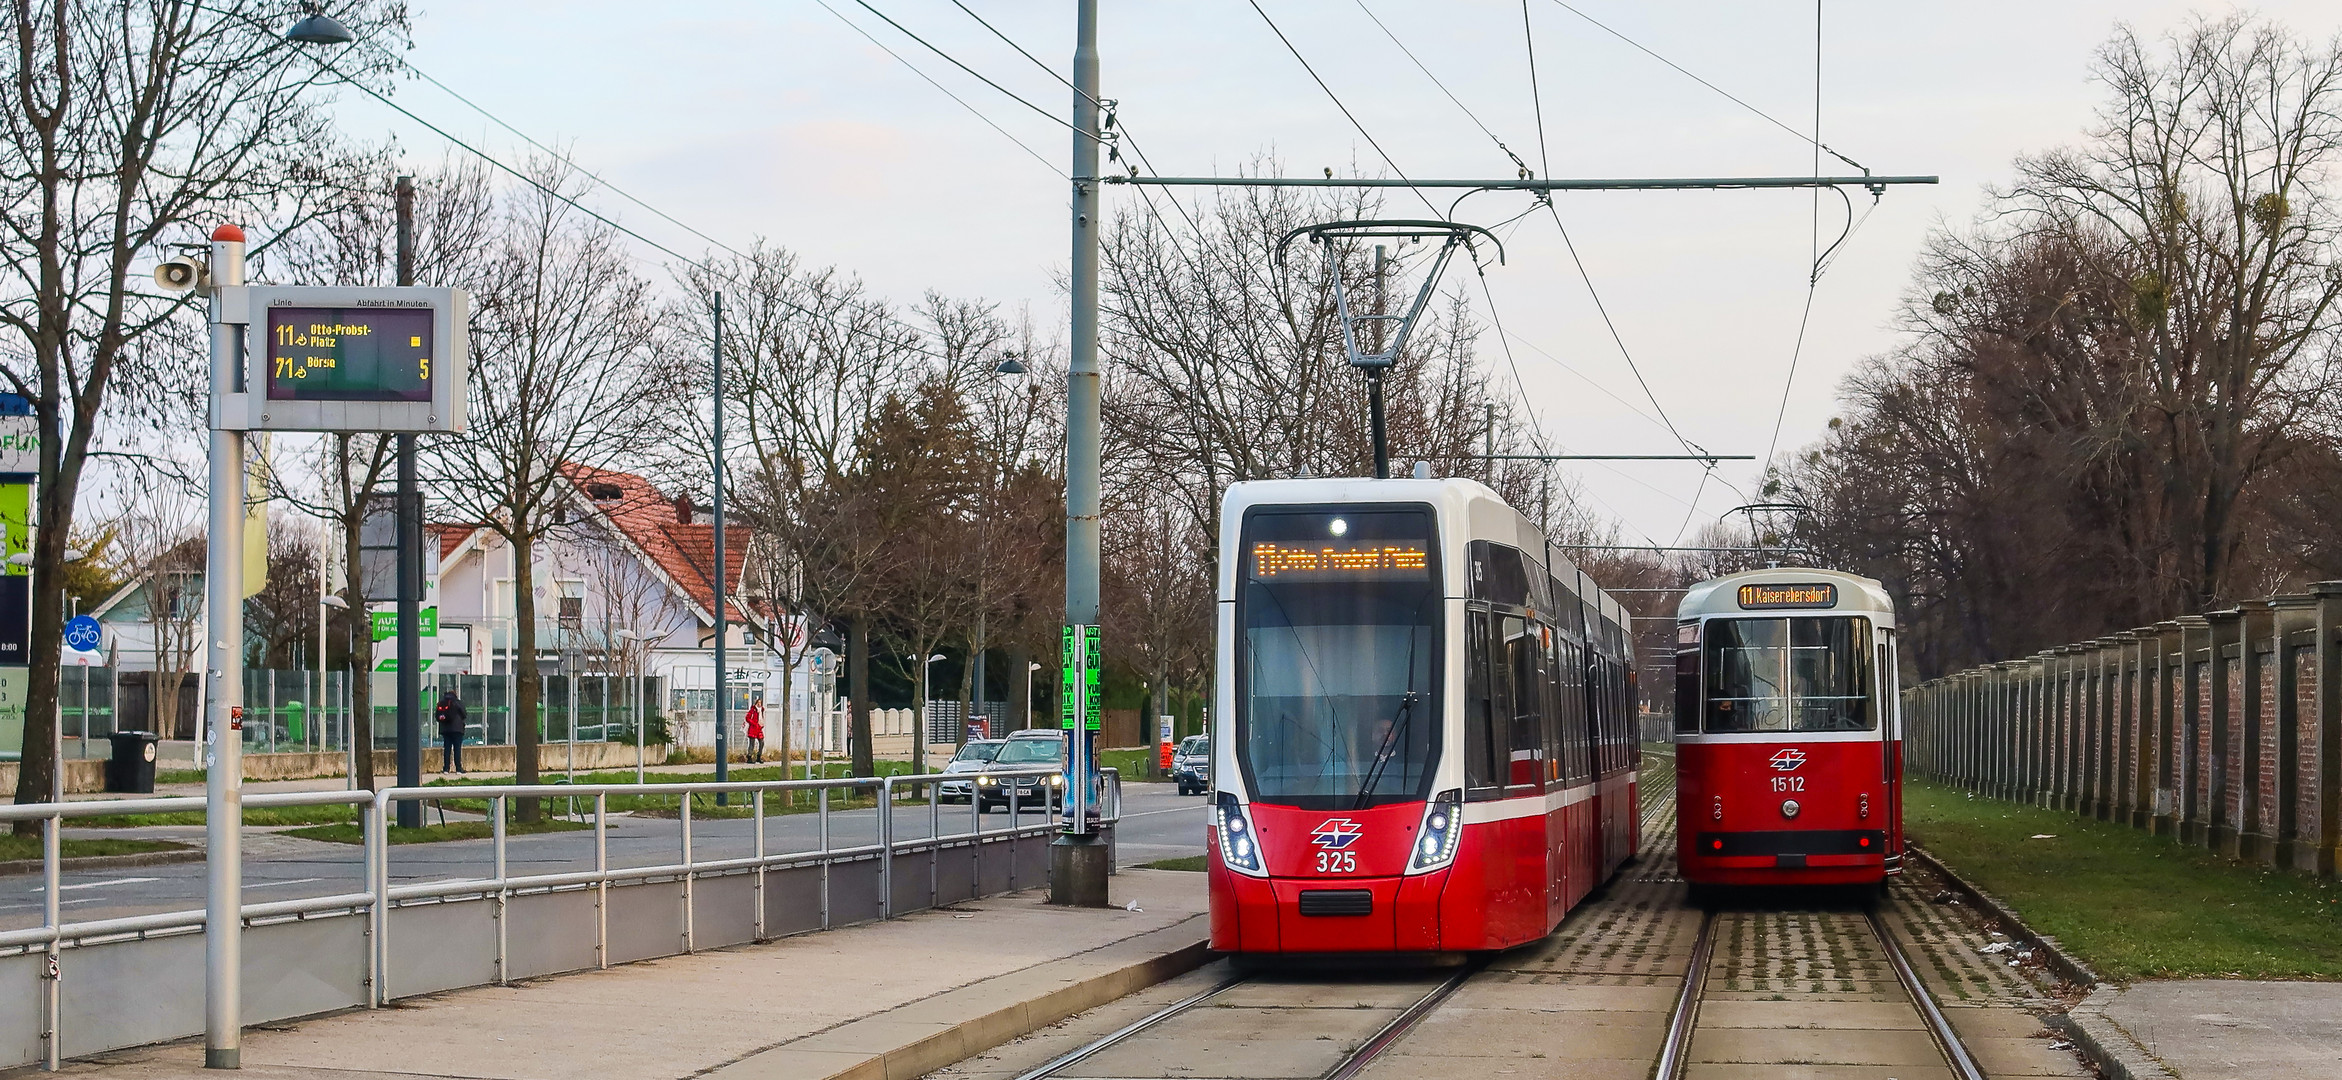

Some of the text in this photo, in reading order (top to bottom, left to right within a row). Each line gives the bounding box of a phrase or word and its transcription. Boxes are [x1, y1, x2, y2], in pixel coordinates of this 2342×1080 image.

[356, 299, 386, 307] Abfahrt
[387, 299, 395, 307] in
[276, 324, 372, 346] 11 Otto-Probst-
[310, 336, 336, 348] Platz
[275, 356, 429, 380] 71 Börse 5
[1254, 544, 1276, 576] 11
[1740, 585, 1832, 605] 11 Kaiserebersdorf
[1770, 776, 1806, 793] 1512
[1315, 850, 1357, 873] 325
